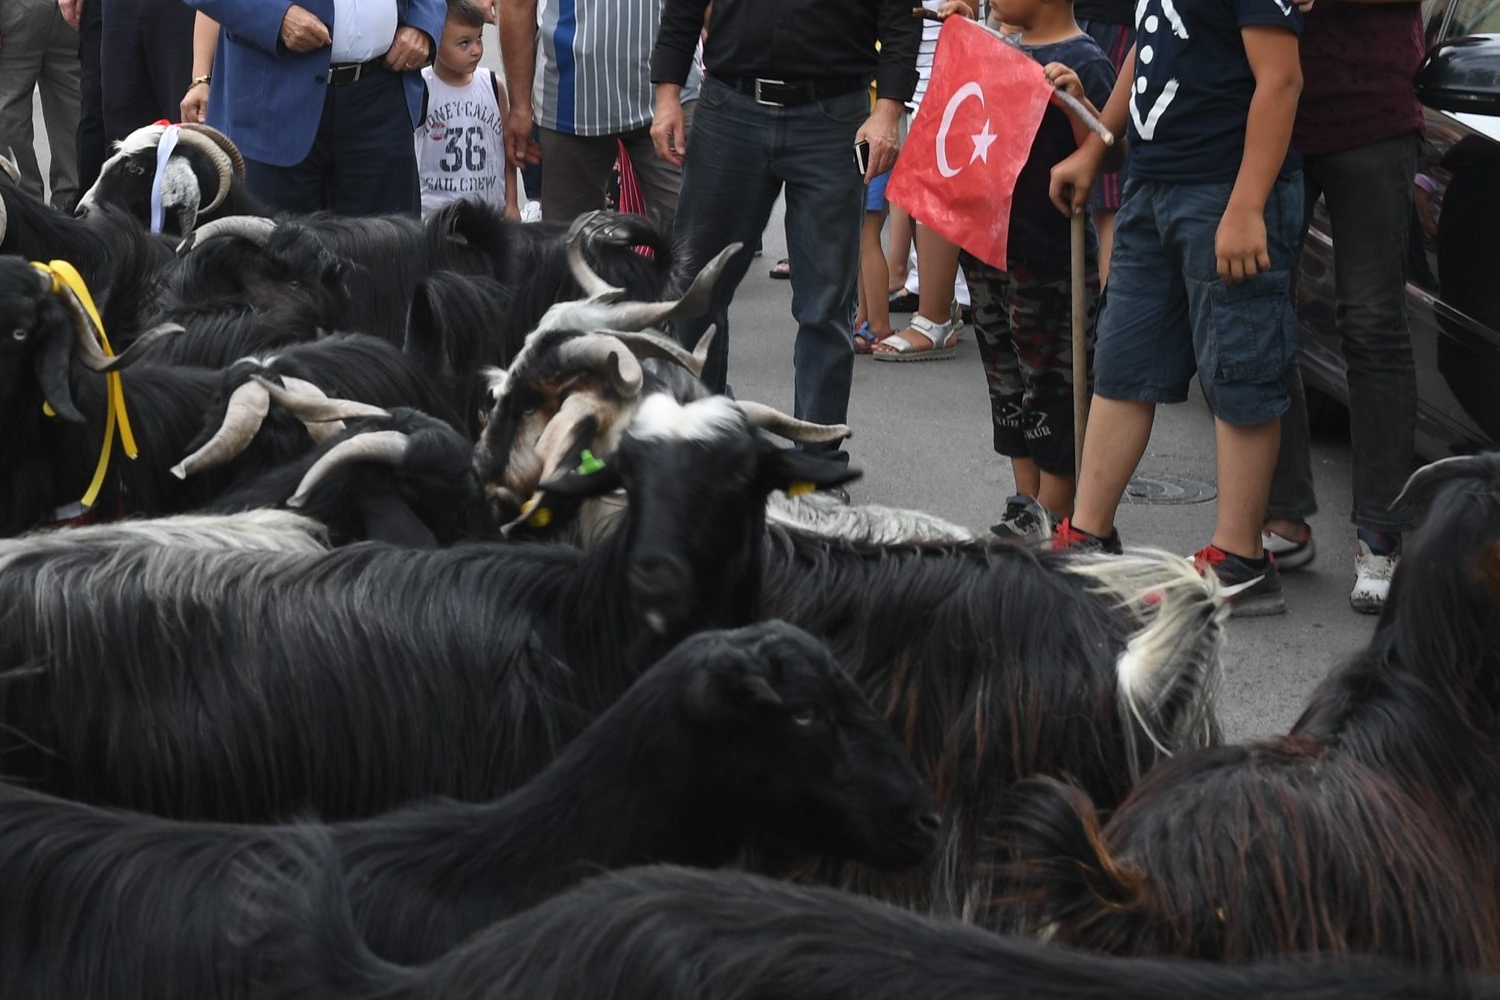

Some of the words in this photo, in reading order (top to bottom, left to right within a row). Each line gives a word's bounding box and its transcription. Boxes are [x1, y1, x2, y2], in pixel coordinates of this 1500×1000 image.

[439, 126, 487, 173] 36
[425, 176, 457, 193] SAIL
[459, 175, 497, 193] CREW
